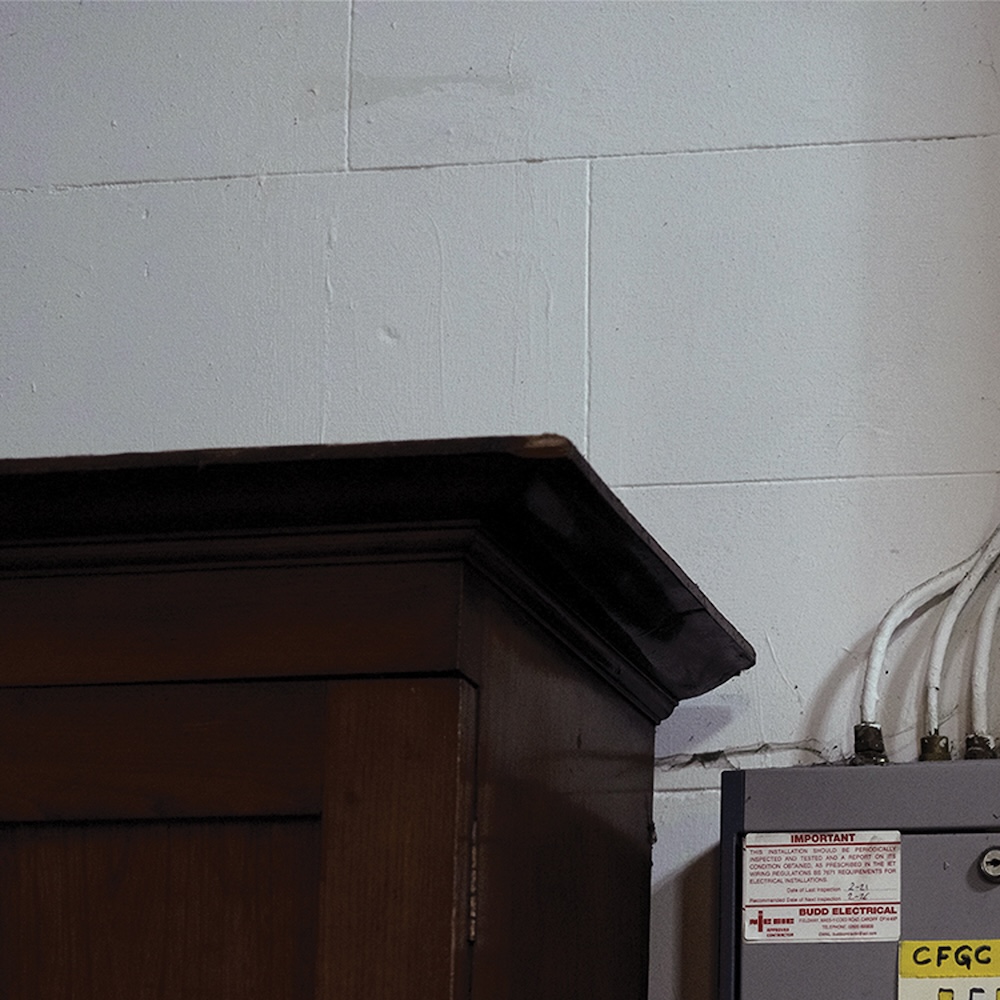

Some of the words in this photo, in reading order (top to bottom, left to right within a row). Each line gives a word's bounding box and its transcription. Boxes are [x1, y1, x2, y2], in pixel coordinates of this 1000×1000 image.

[791, 834, 855, 843] IMPORTANT
[799, 908, 829, 916] BUDD
[832, 907, 897, 915] ELECTRICAL
[913, 946, 992, 970] CFGC
